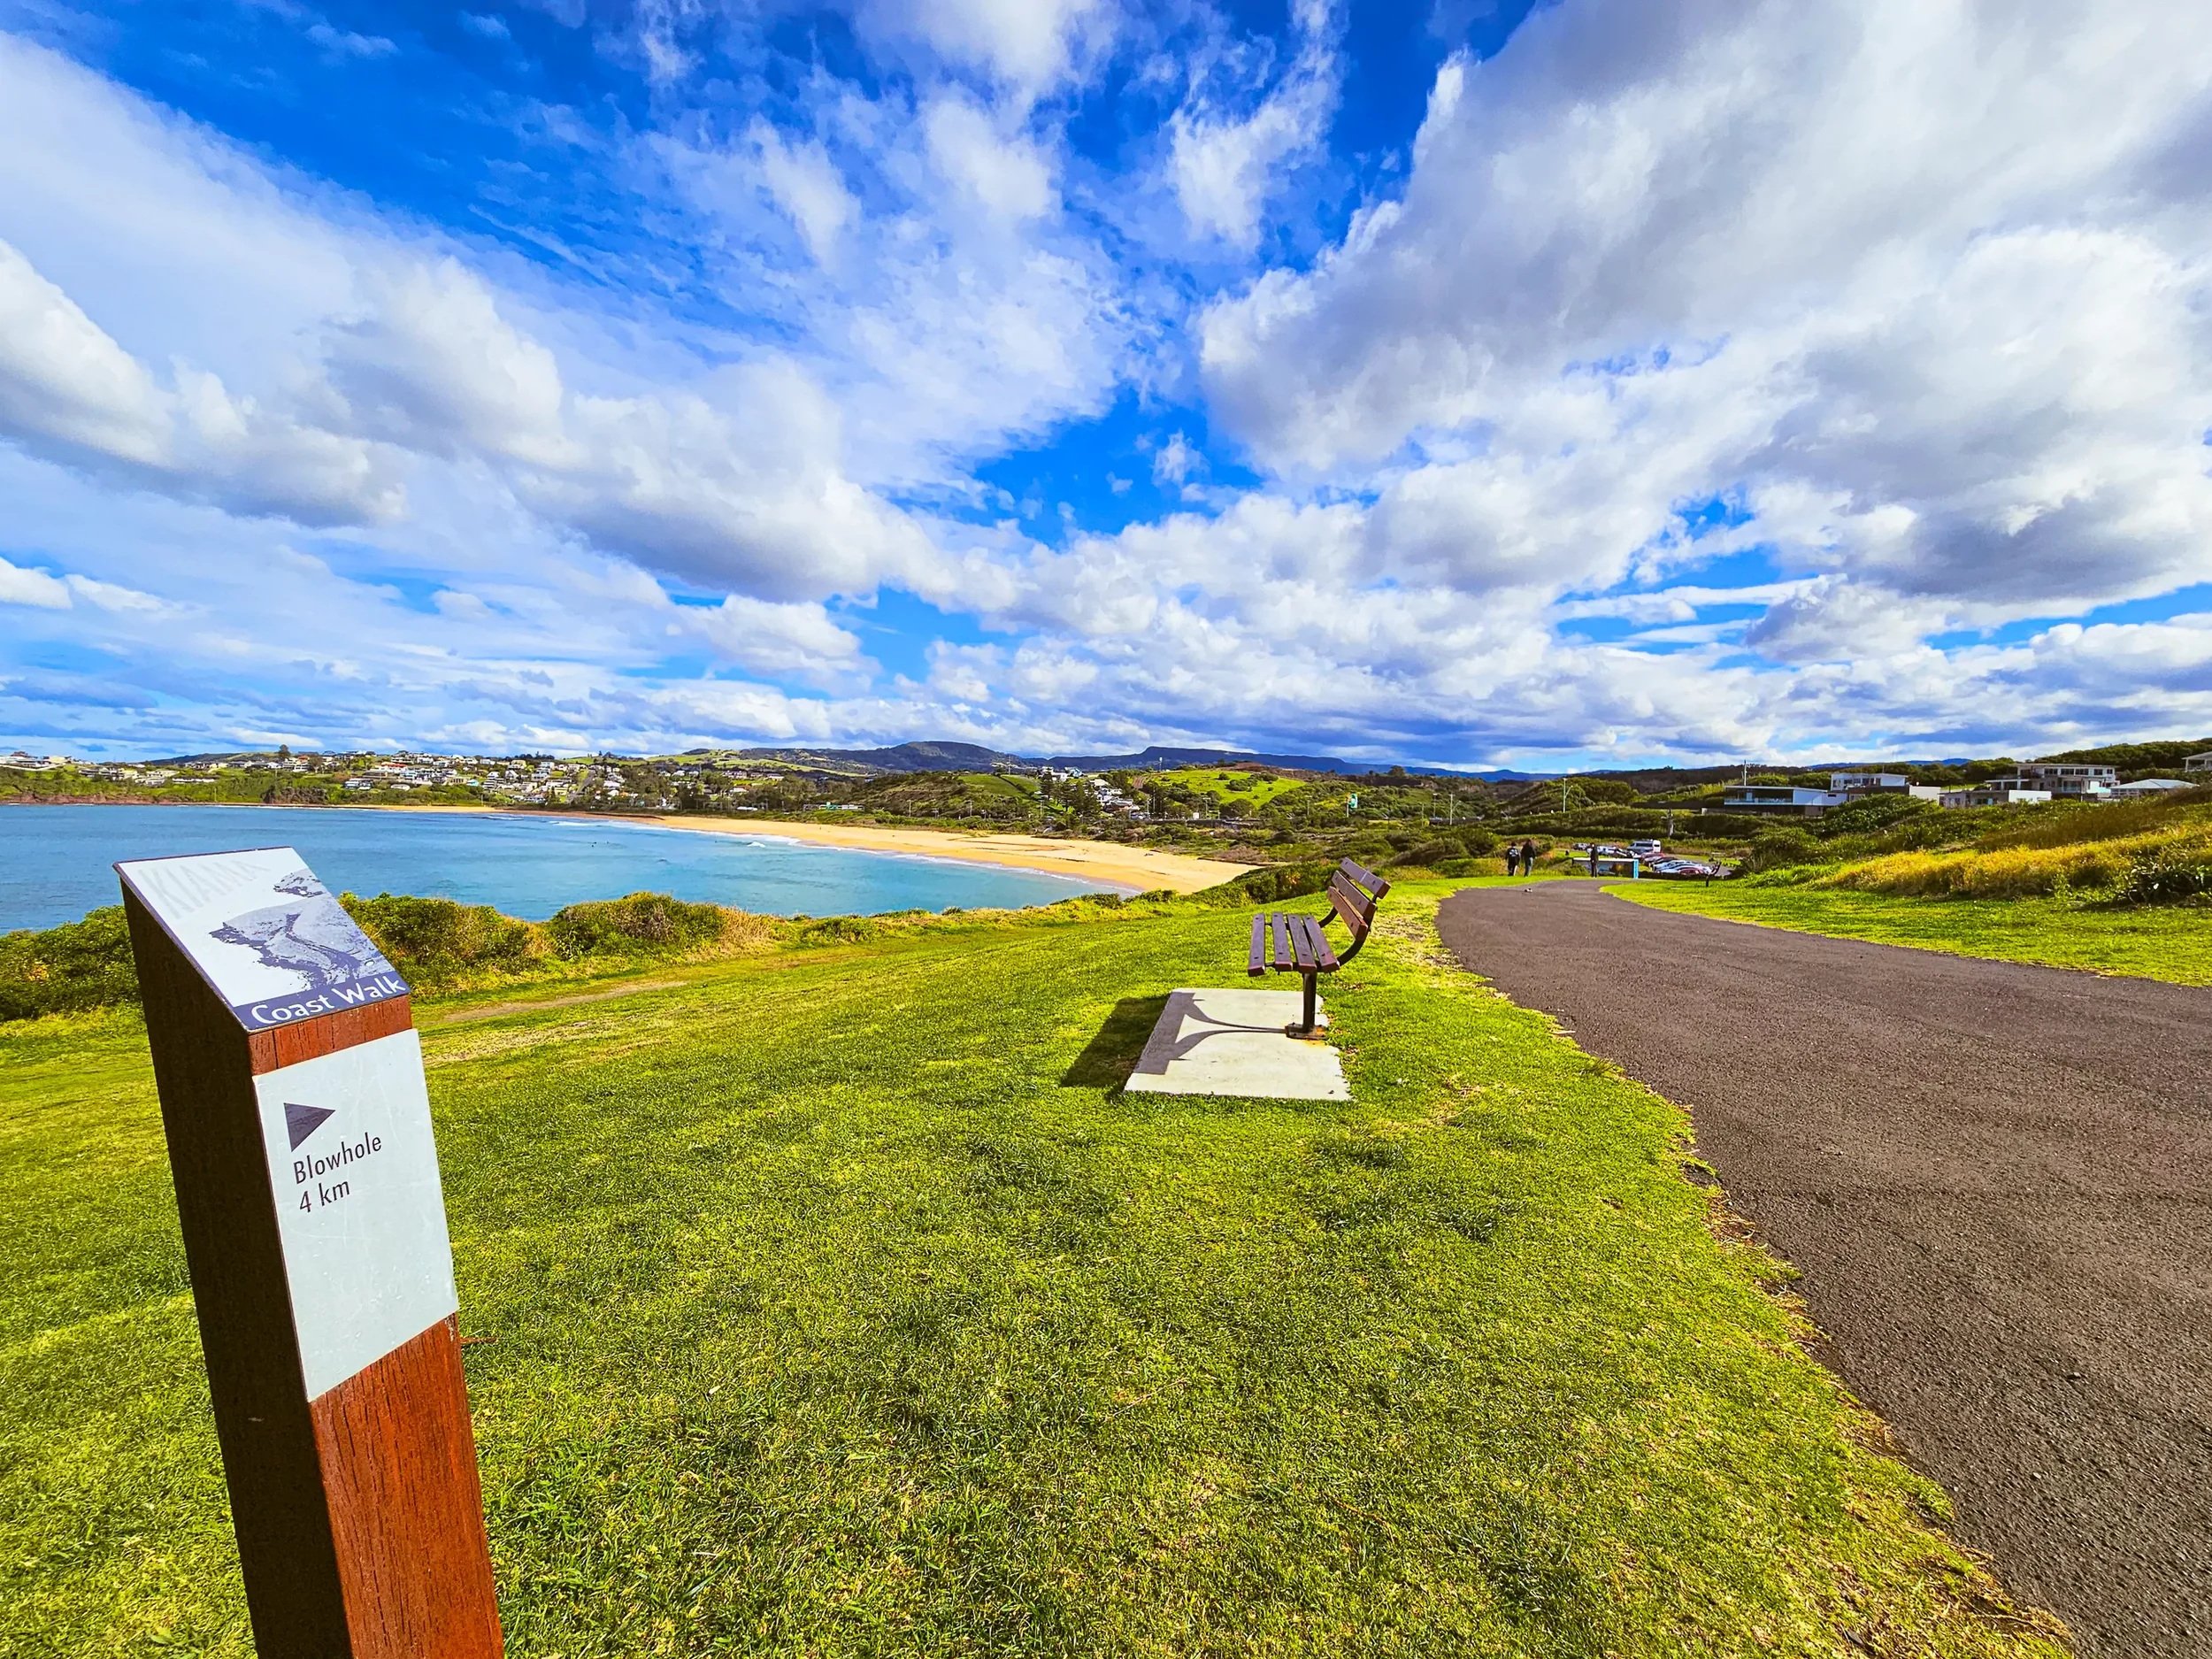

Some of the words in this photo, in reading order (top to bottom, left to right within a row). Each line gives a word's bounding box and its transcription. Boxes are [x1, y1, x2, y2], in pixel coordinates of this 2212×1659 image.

[136, 860, 272, 920] KIAMA
[251, 995, 335, 1025] Coast
[332, 976, 407, 1004] Walk
[293, 1132, 382, 1185] Blowhole
[299, 1190, 312, 1214] 4
[318, 1181, 350, 1207] km
